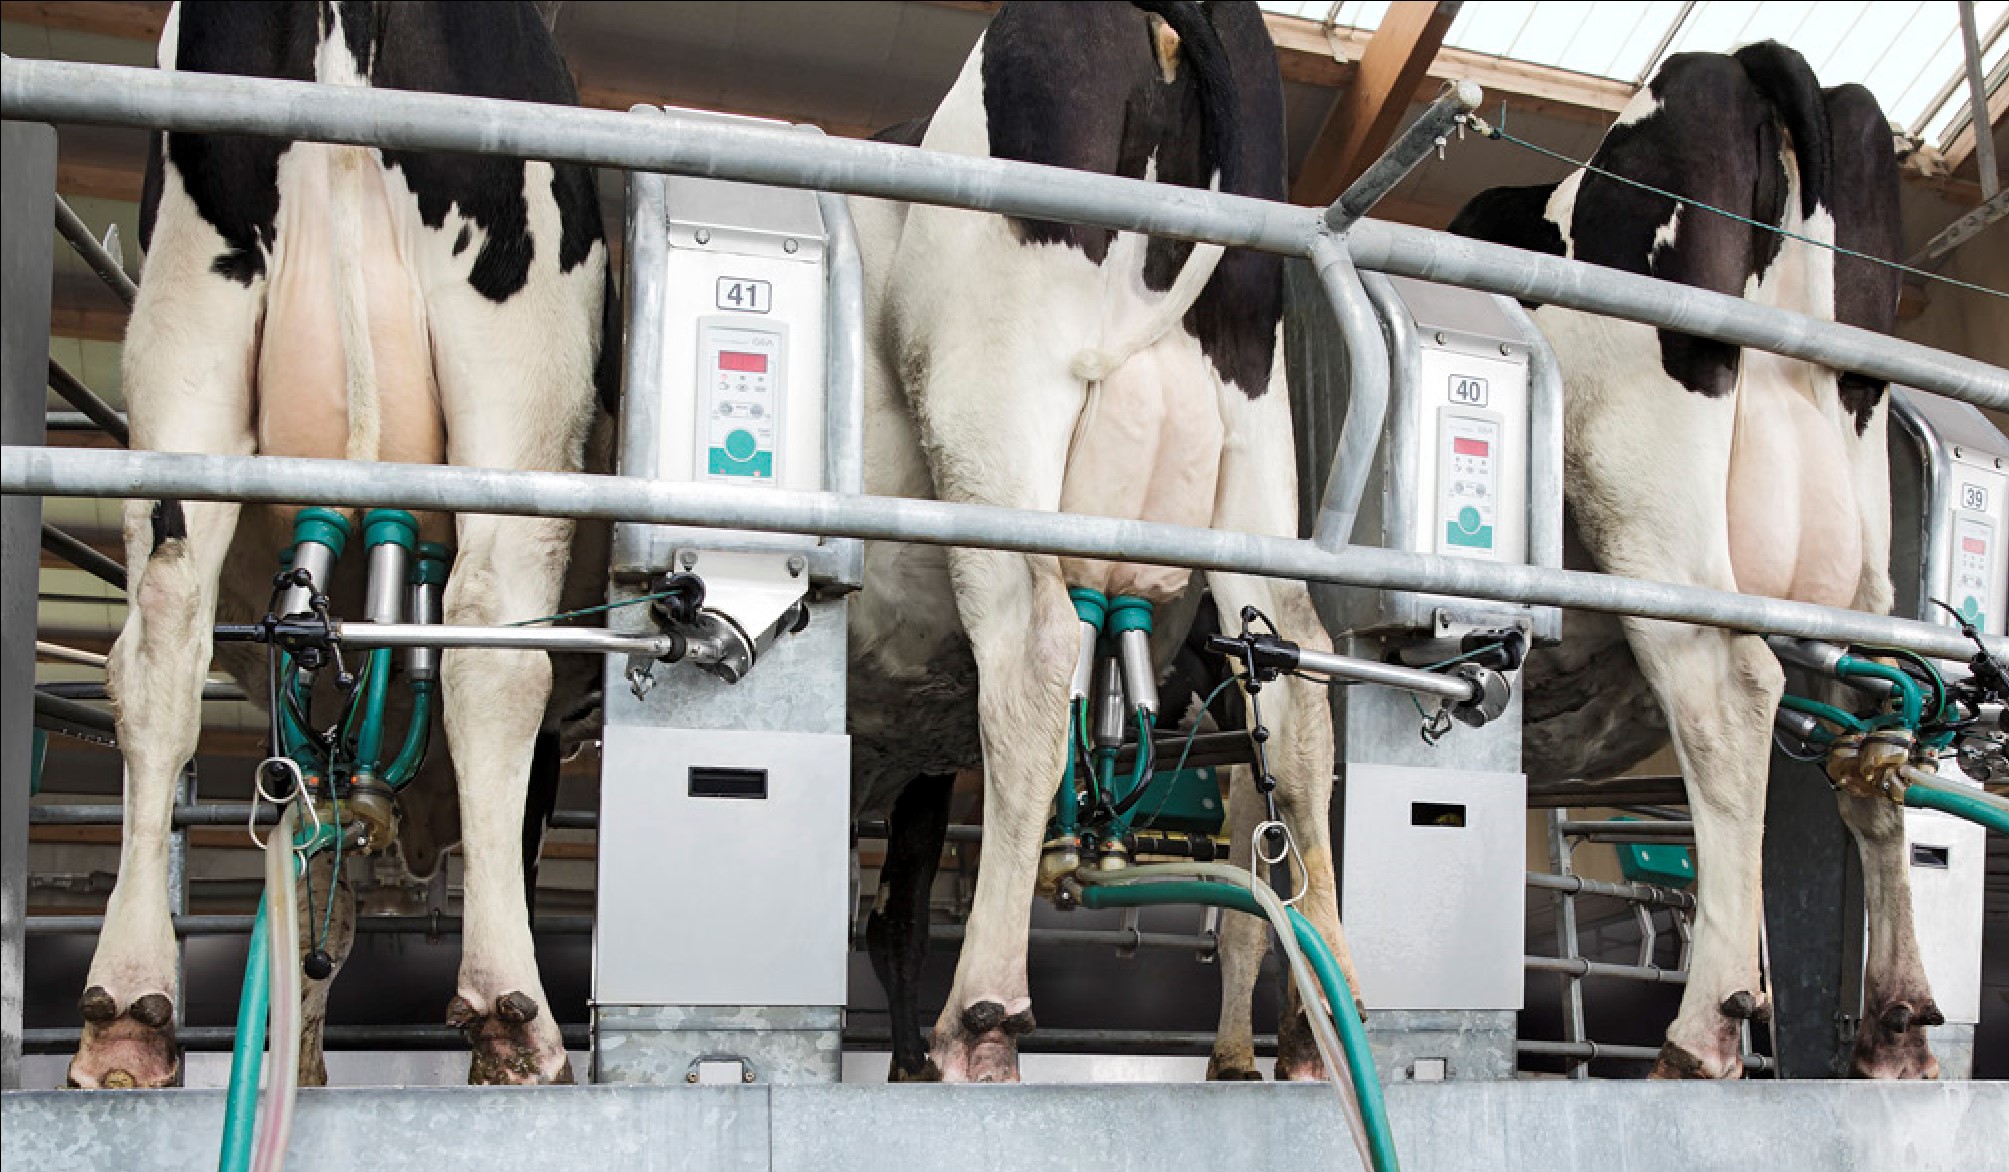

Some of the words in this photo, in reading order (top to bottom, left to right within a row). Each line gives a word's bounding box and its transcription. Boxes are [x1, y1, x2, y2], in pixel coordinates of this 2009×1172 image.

[727, 283, 756, 306] 41
[1456, 380, 1481, 402] 40
[1966, 488, 1983, 508] 39
